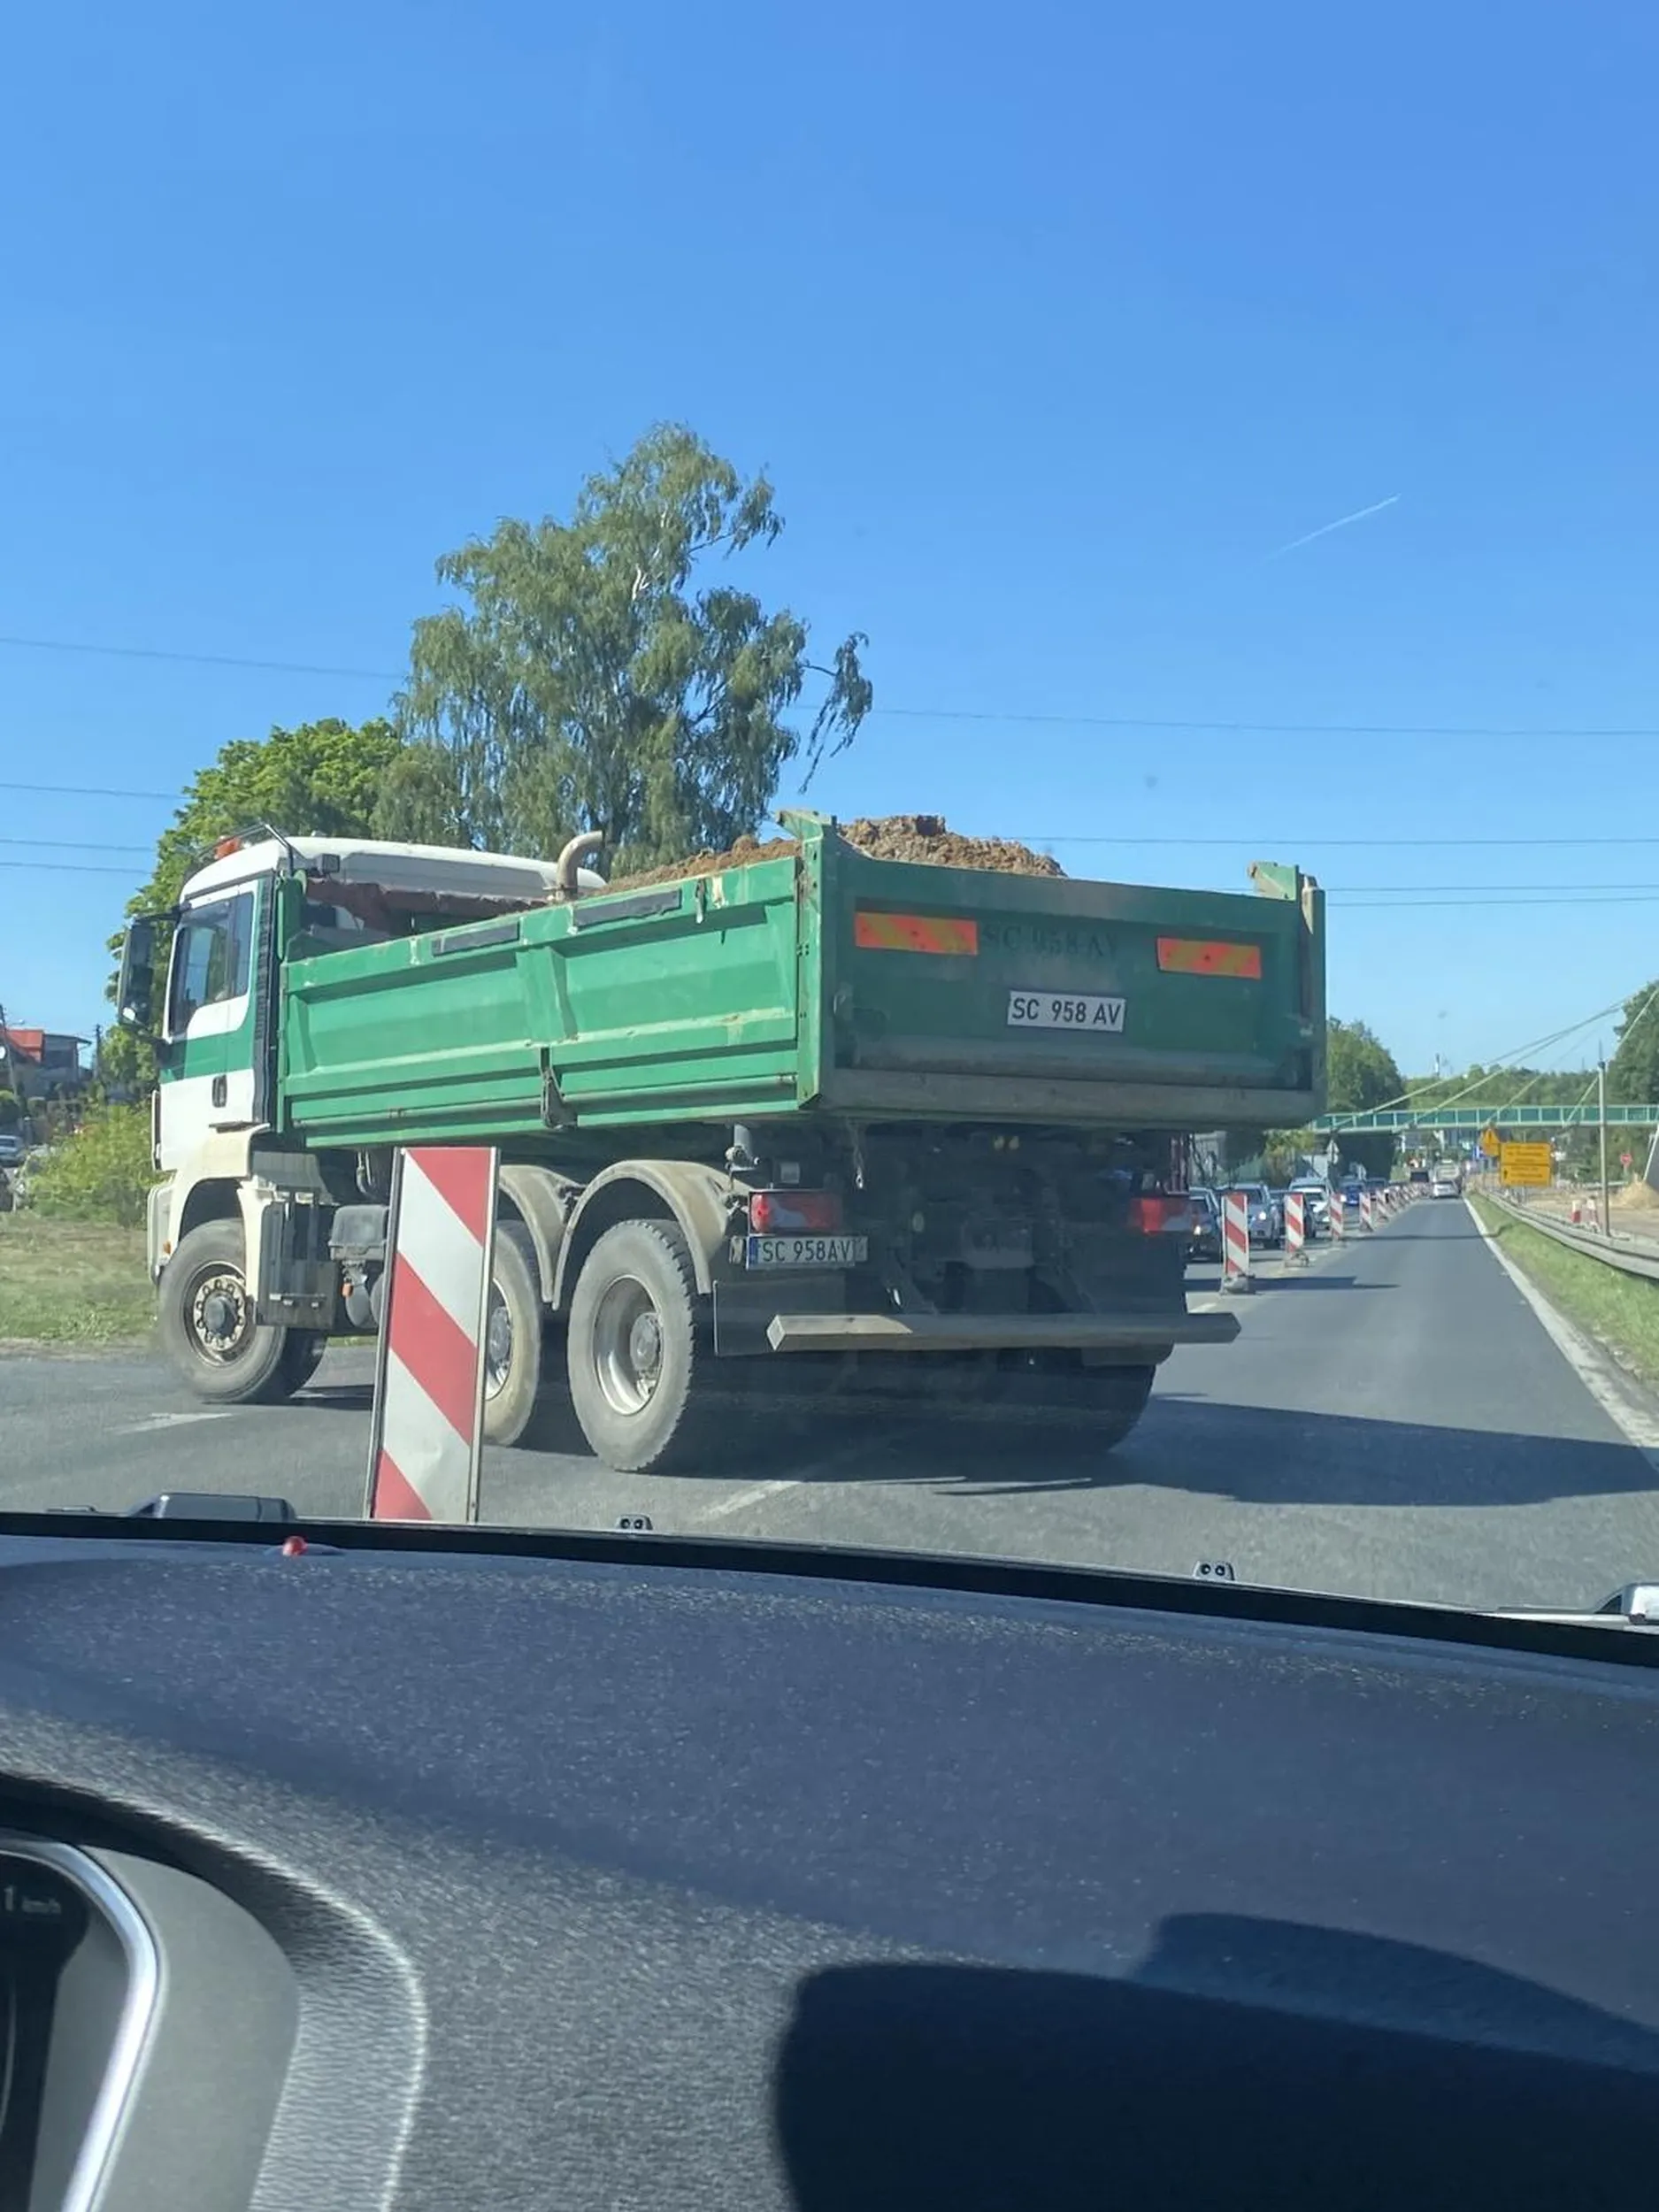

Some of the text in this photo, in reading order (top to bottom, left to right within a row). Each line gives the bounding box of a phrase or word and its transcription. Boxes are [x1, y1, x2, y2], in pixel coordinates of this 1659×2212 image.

[1011, 997, 1121, 1025] SC 958 AV
[762, 1240, 786, 1262] SC
